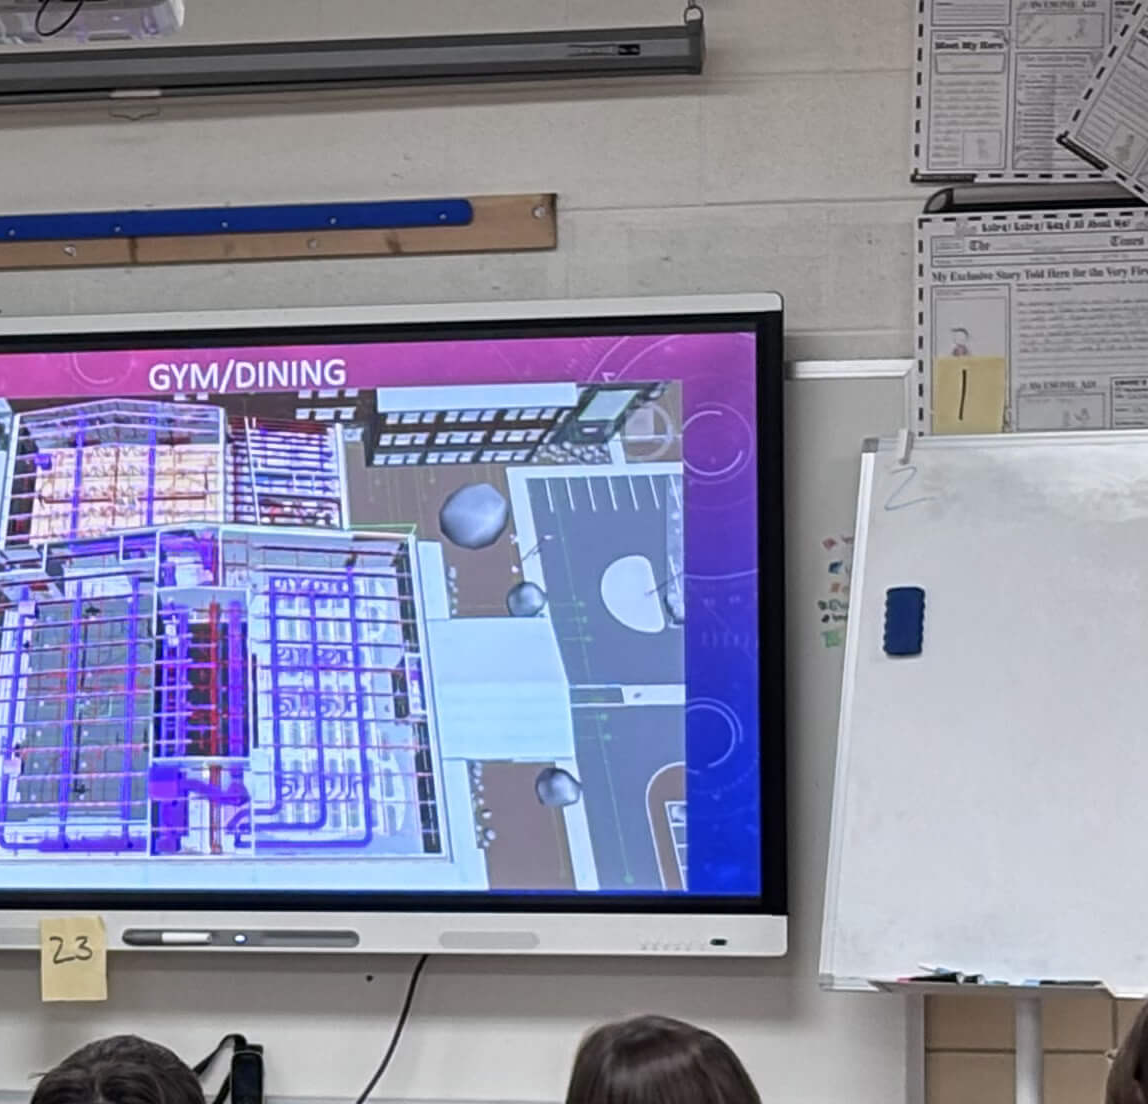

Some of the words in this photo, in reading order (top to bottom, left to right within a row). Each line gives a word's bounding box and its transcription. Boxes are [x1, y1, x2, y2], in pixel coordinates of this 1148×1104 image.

[962, 42, 976, 50] My
[932, 272, 948, 282] My
[951, 270, 993, 281] Exclusive
[996, 270, 1021, 282] Story
[1024, 268, 1044, 280] Told
[1048, 268, 1070, 278] Here
[1072, 267, 1086, 278] for
[1089, 266, 1104, 277] the
[1106, 266, 1128, 278] Very
[148, 358, 347, 394] GYM/DINING
[49, 935, 93, 965] 23
